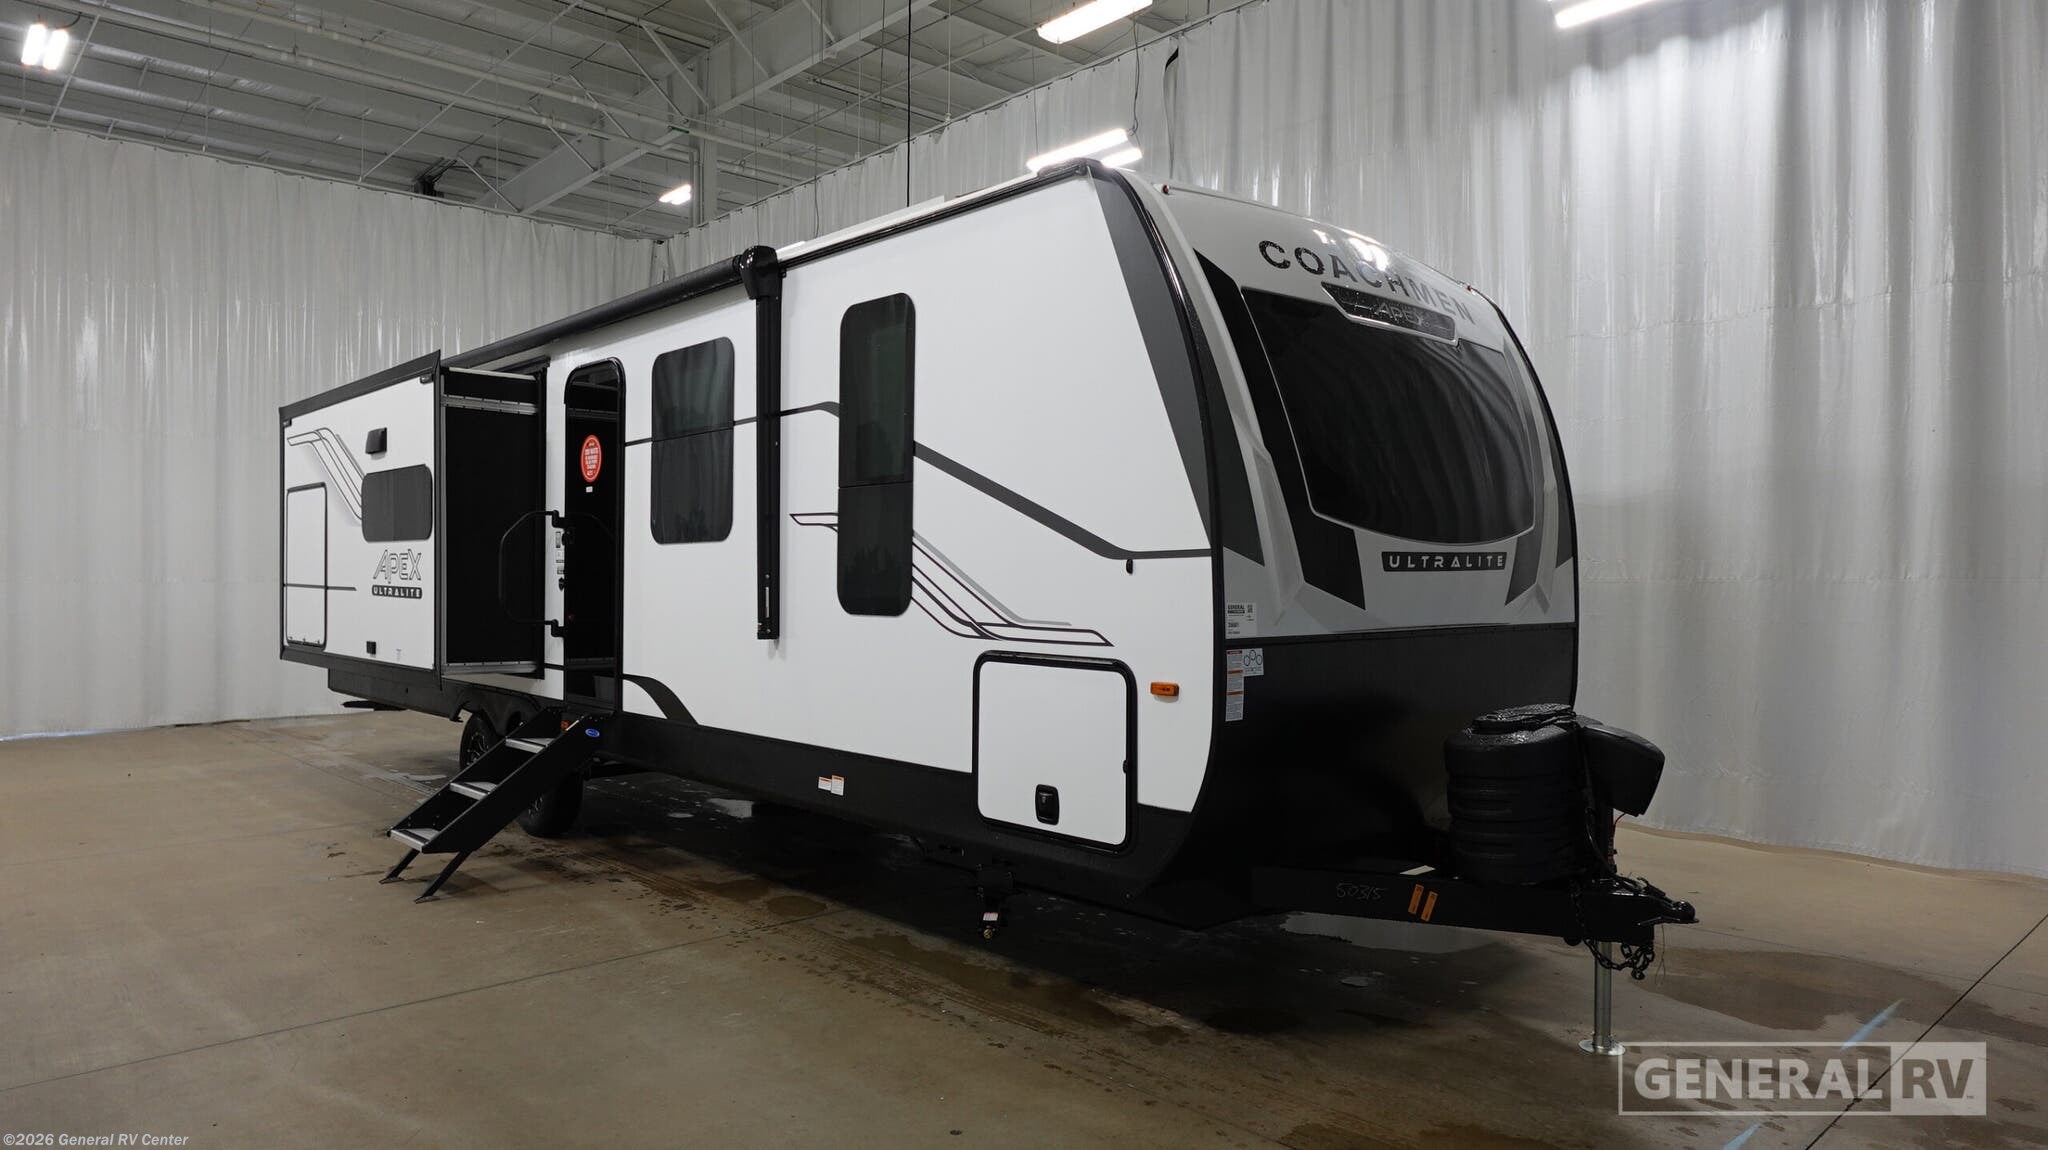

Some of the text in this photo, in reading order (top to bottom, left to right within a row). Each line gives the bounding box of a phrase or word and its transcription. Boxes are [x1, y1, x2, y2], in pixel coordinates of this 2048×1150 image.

[1258, 240, 1476, 325] COACHMEN
[373, 548, 421, 584] APEX
[1389, 555, 1503, 568] ULTRALITE
[373, 586, 421, 598] ULTRALITE
